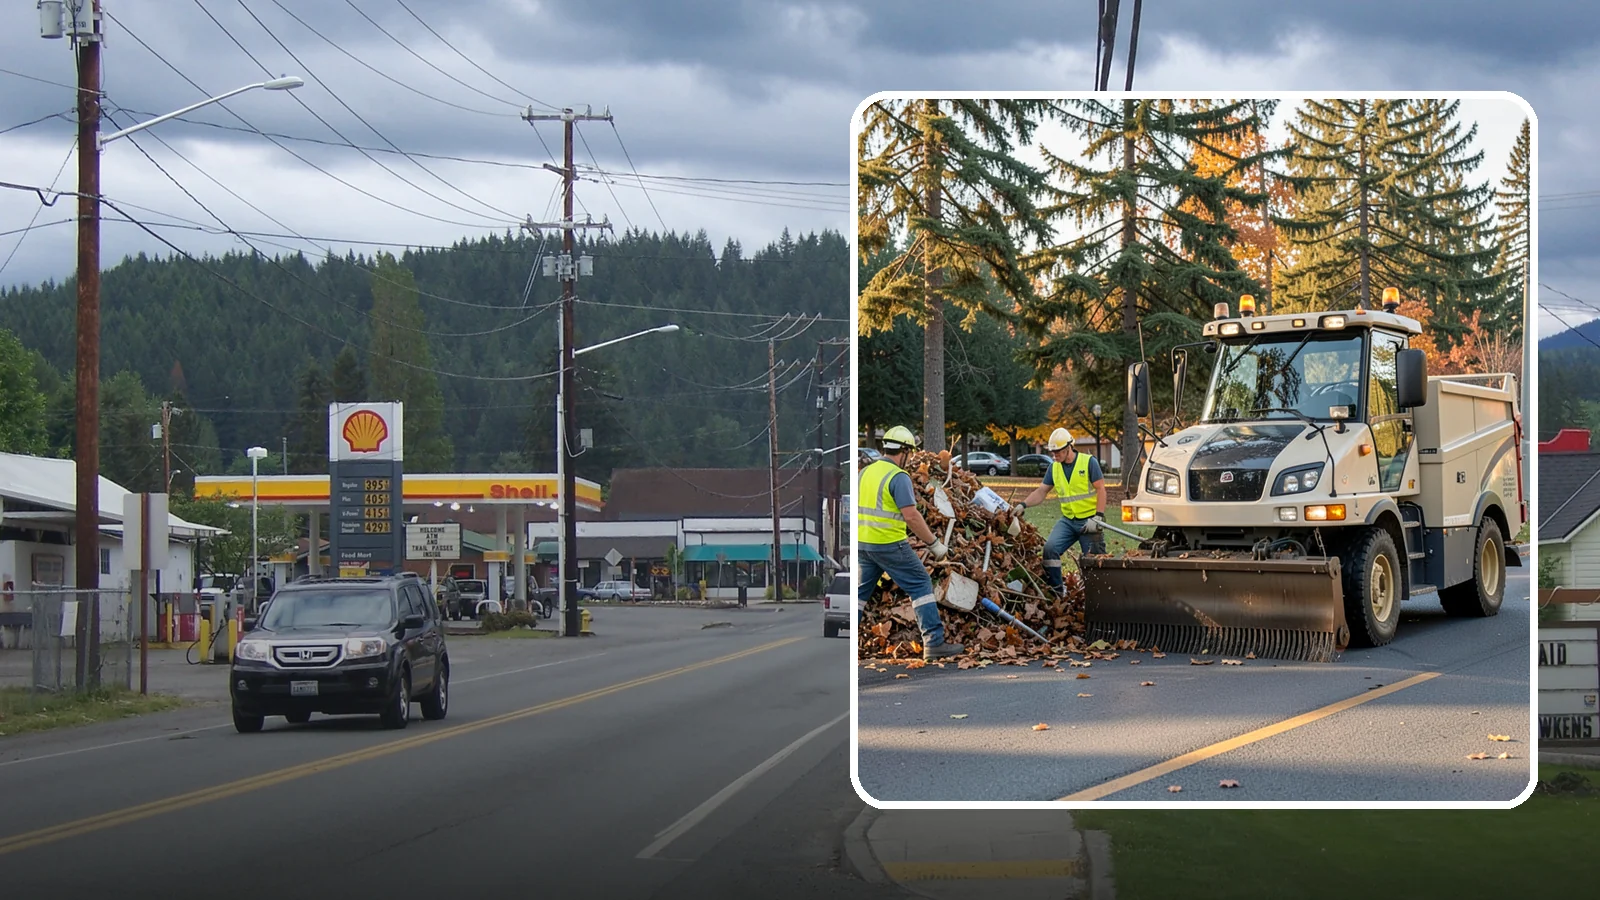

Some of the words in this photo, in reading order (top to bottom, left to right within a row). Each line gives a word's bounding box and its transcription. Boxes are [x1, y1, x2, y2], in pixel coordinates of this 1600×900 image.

[366, 480, 384, 490] 395
[490, 484, 548, 499] Shell
[366, 494, 384, 504] 405
[366, 508, 384, 518] 415
[366, 522, 384, 533] 429
[1538, 643, 1566, 665] AID
